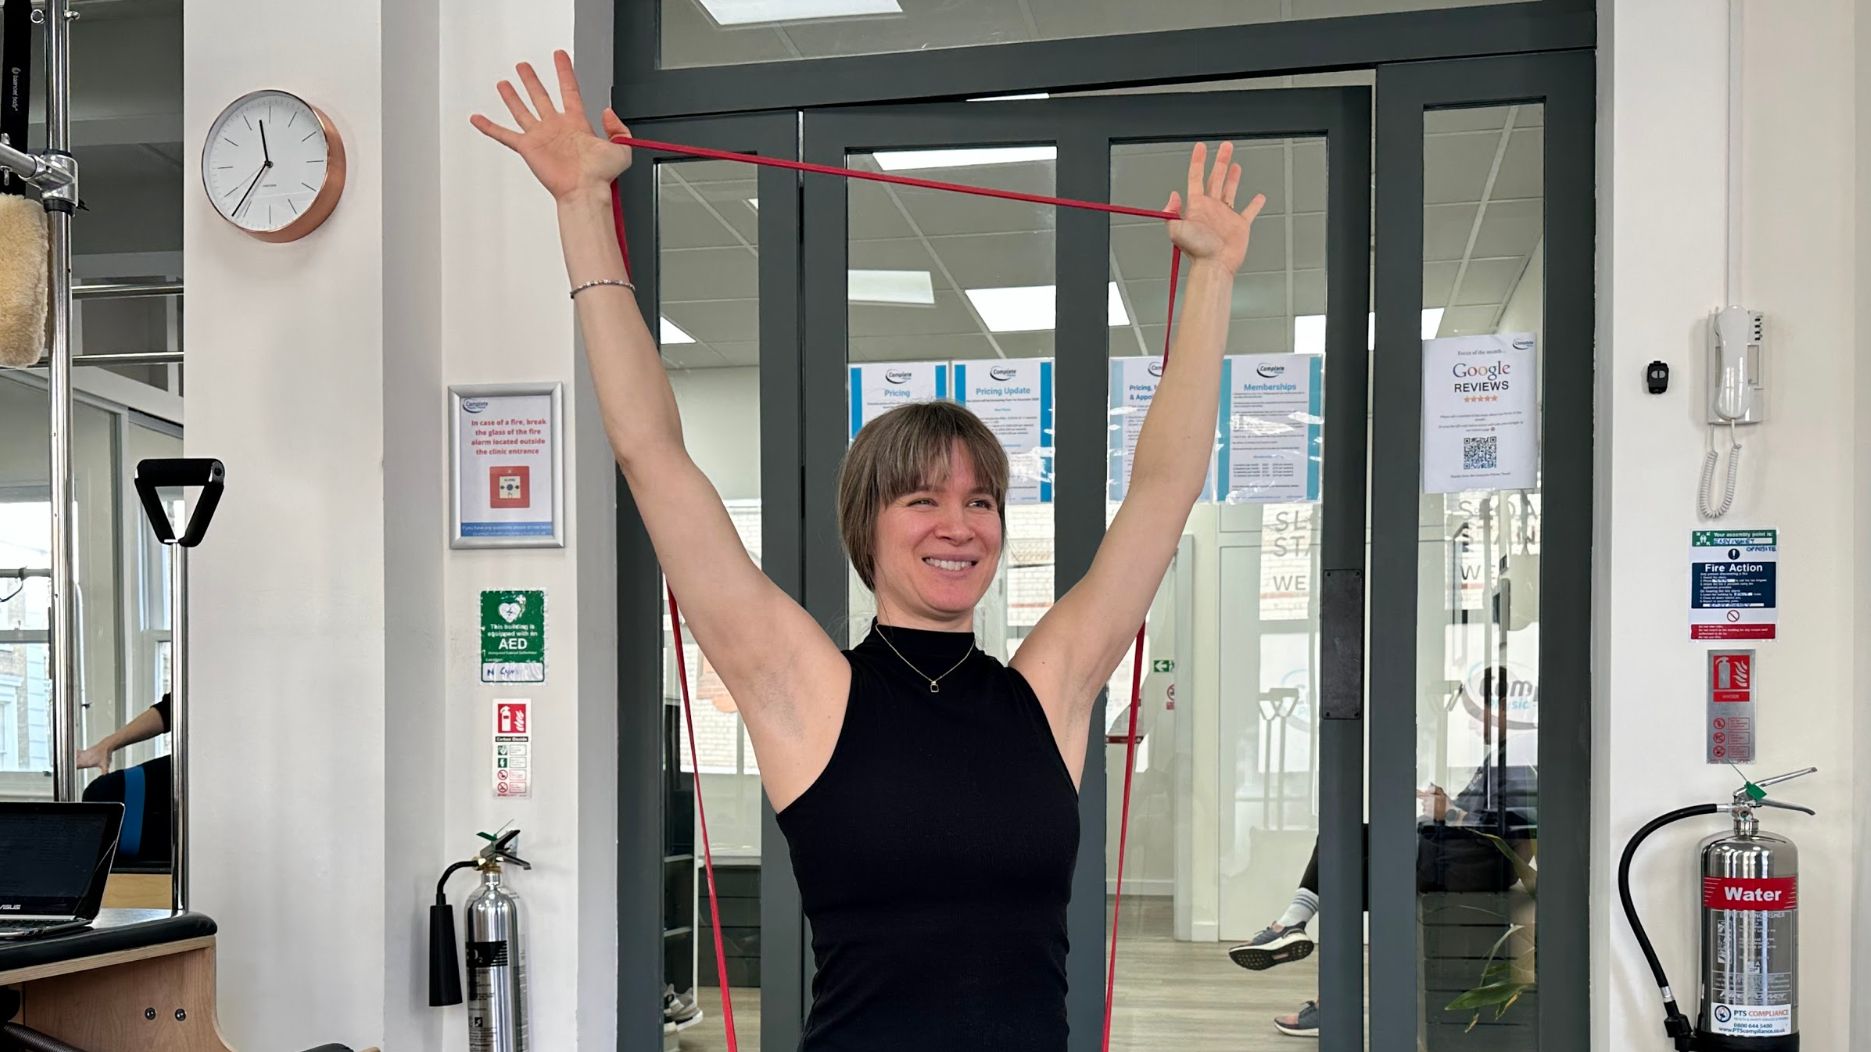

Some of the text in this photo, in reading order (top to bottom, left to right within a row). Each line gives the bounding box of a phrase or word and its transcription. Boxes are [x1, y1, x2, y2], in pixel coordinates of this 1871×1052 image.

[1452, 360, 1511, 381] Google
[1244, 383, 1297, 391] Memberships
[1454, 380, 1509, 393] REVIEWS
[884, 390, 911, 398] Pricing
[976, 387, 1031, 396] Pricing Update
[489, 429, 505, 437] glass
[1705, 563, 1763, 572] Fire Action
[498, 638, 528, 650] AED
[1724, 886, 1782, 902] Water
[1749, 1009, 1789, 1017] COMPLIANCE
